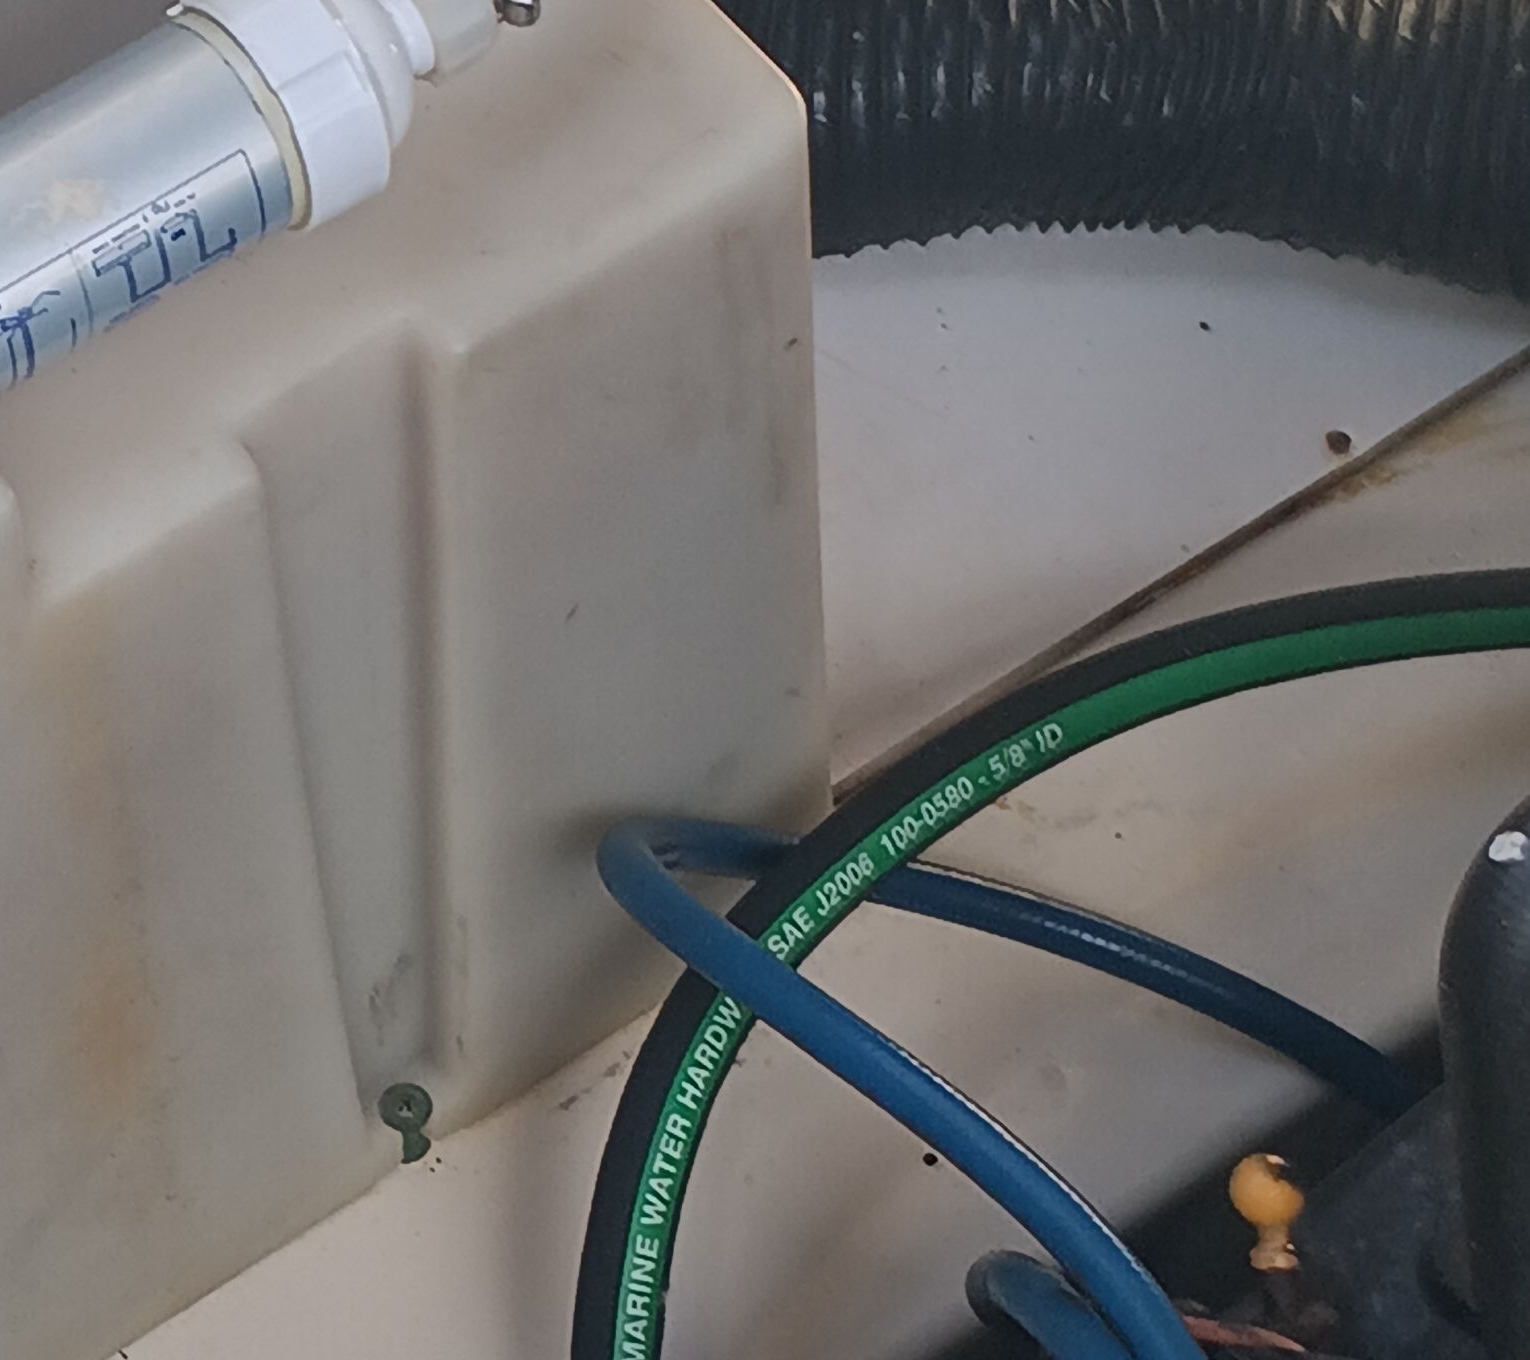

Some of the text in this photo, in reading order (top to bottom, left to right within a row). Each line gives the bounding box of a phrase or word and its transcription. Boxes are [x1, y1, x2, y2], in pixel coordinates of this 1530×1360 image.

[639, 1112, 692, 1225] WATER
[676, 995, 743, 1110] HARDW
[767, 905, 816, 961] SAE
[879, 776, 975, 857] 100-0580
